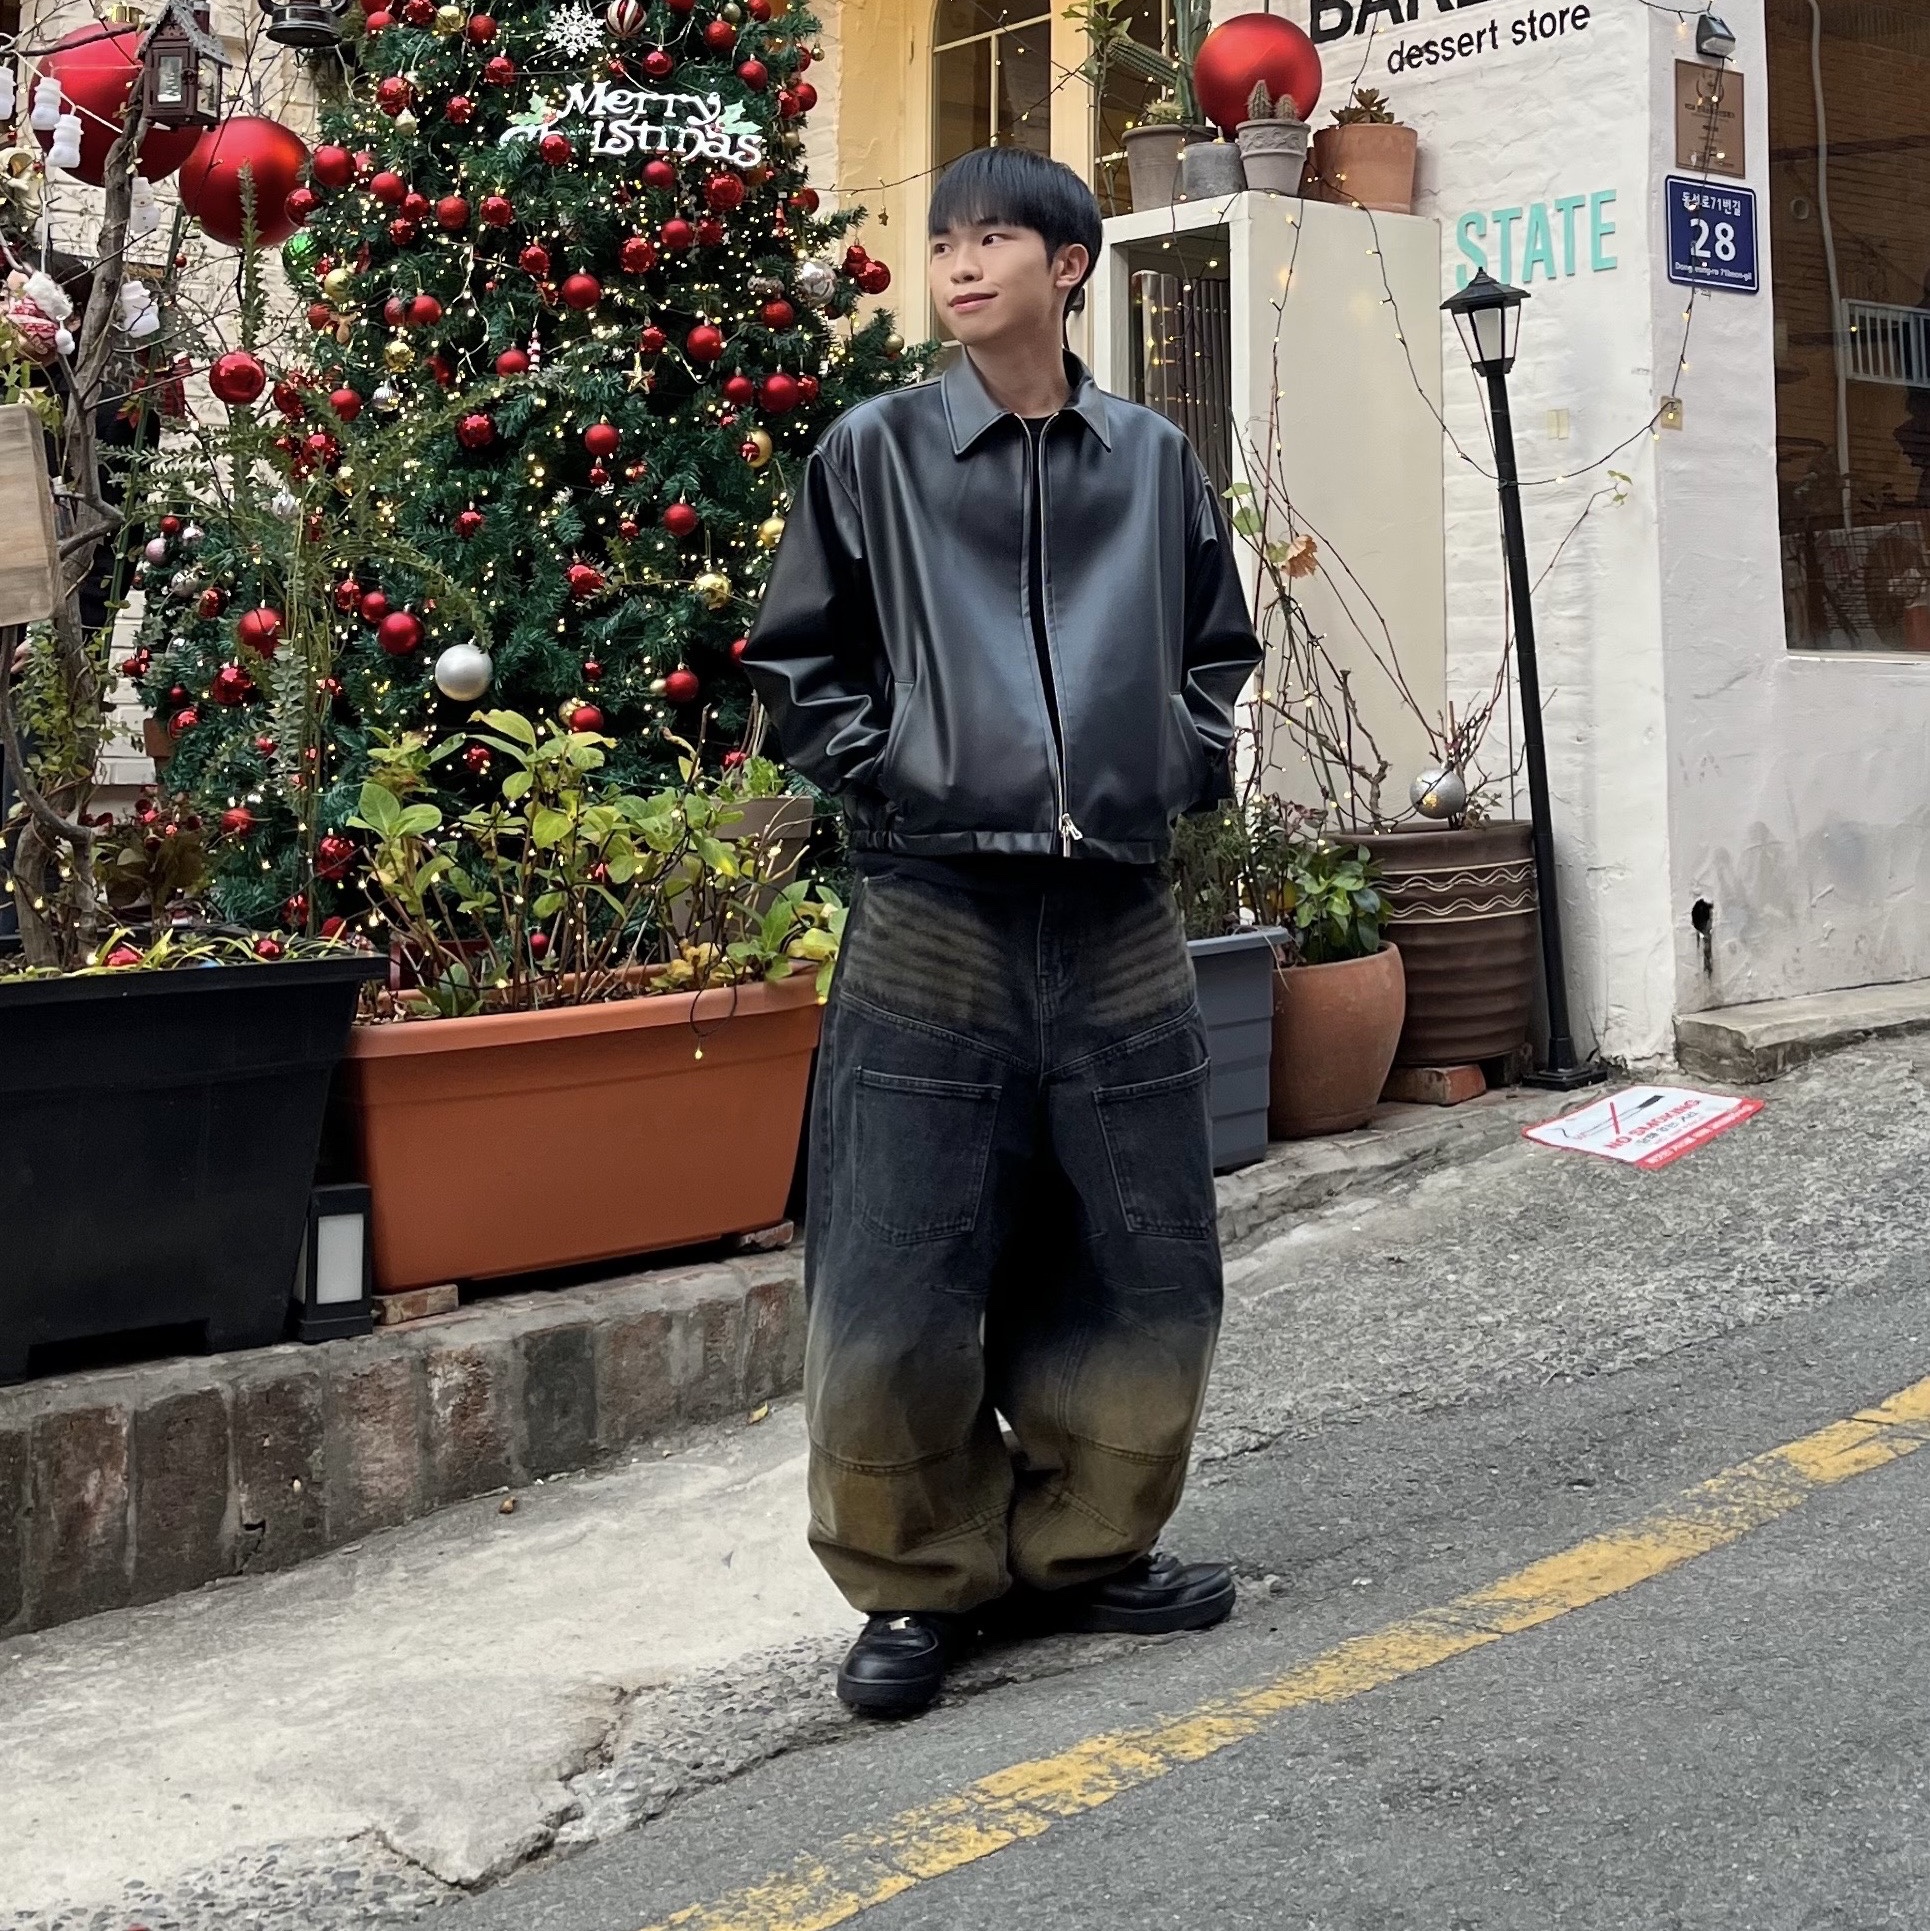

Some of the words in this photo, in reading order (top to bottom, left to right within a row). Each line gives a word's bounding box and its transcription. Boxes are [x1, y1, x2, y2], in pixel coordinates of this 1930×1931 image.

[1387, 19, 1499, 75] dessert
[1511, 4, 1591, 46] store
[546, 80, 722, 126] Merry
[1456, 189, 1618, 289] STATE
[1690, 218, 1736, 261] 28
[1604, 1136, 1632, 1149] NO
